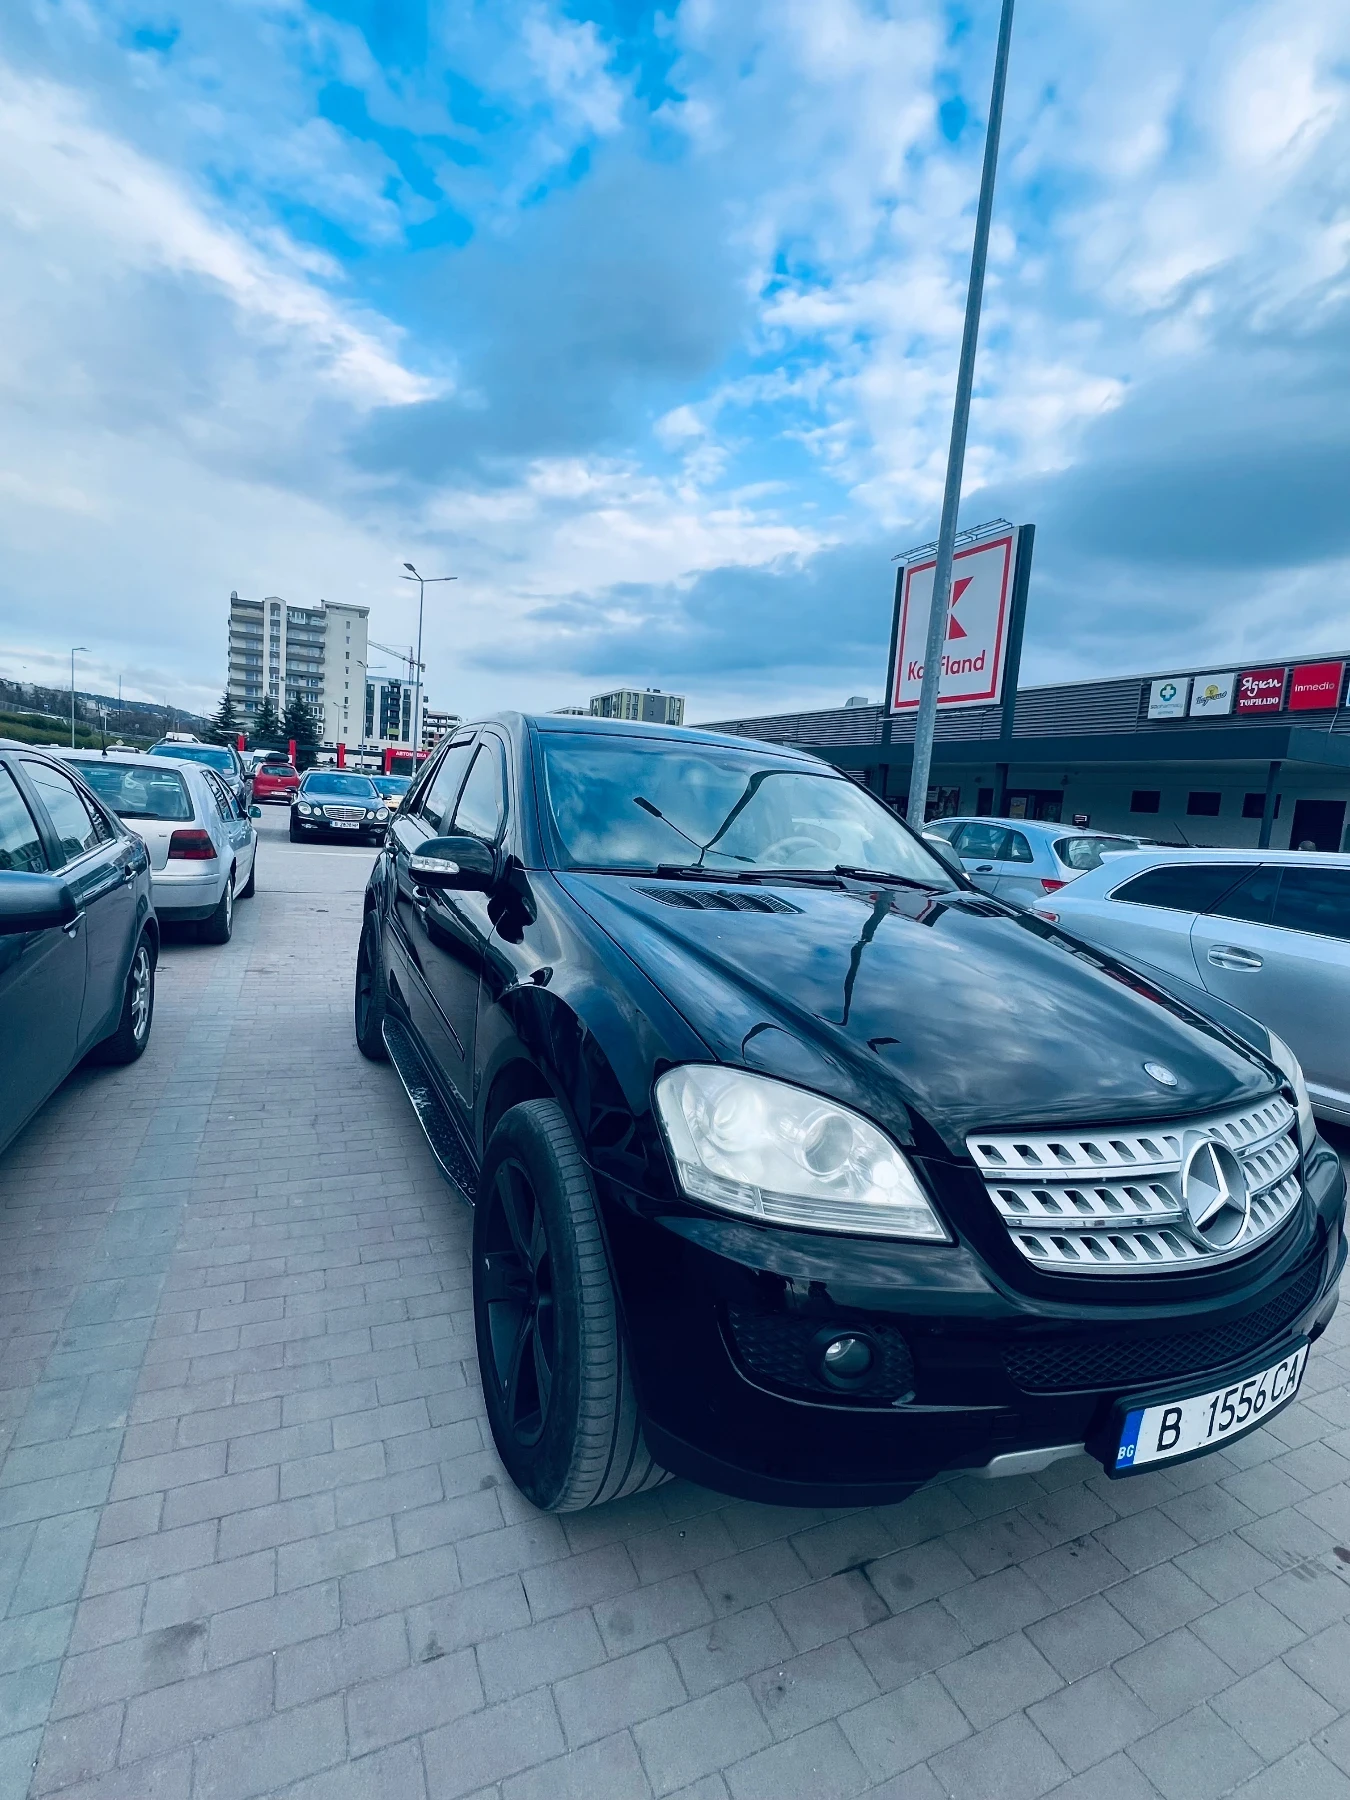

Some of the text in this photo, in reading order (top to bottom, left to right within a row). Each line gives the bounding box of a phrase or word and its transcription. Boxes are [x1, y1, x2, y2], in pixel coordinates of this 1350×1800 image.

[908, 650, 985, 681] Kafland
[1295, 682, 1335, 692] inmedio
[1157, 1407, 1182, 1452] B
[1118, 1445, 1135, 1460] BG
